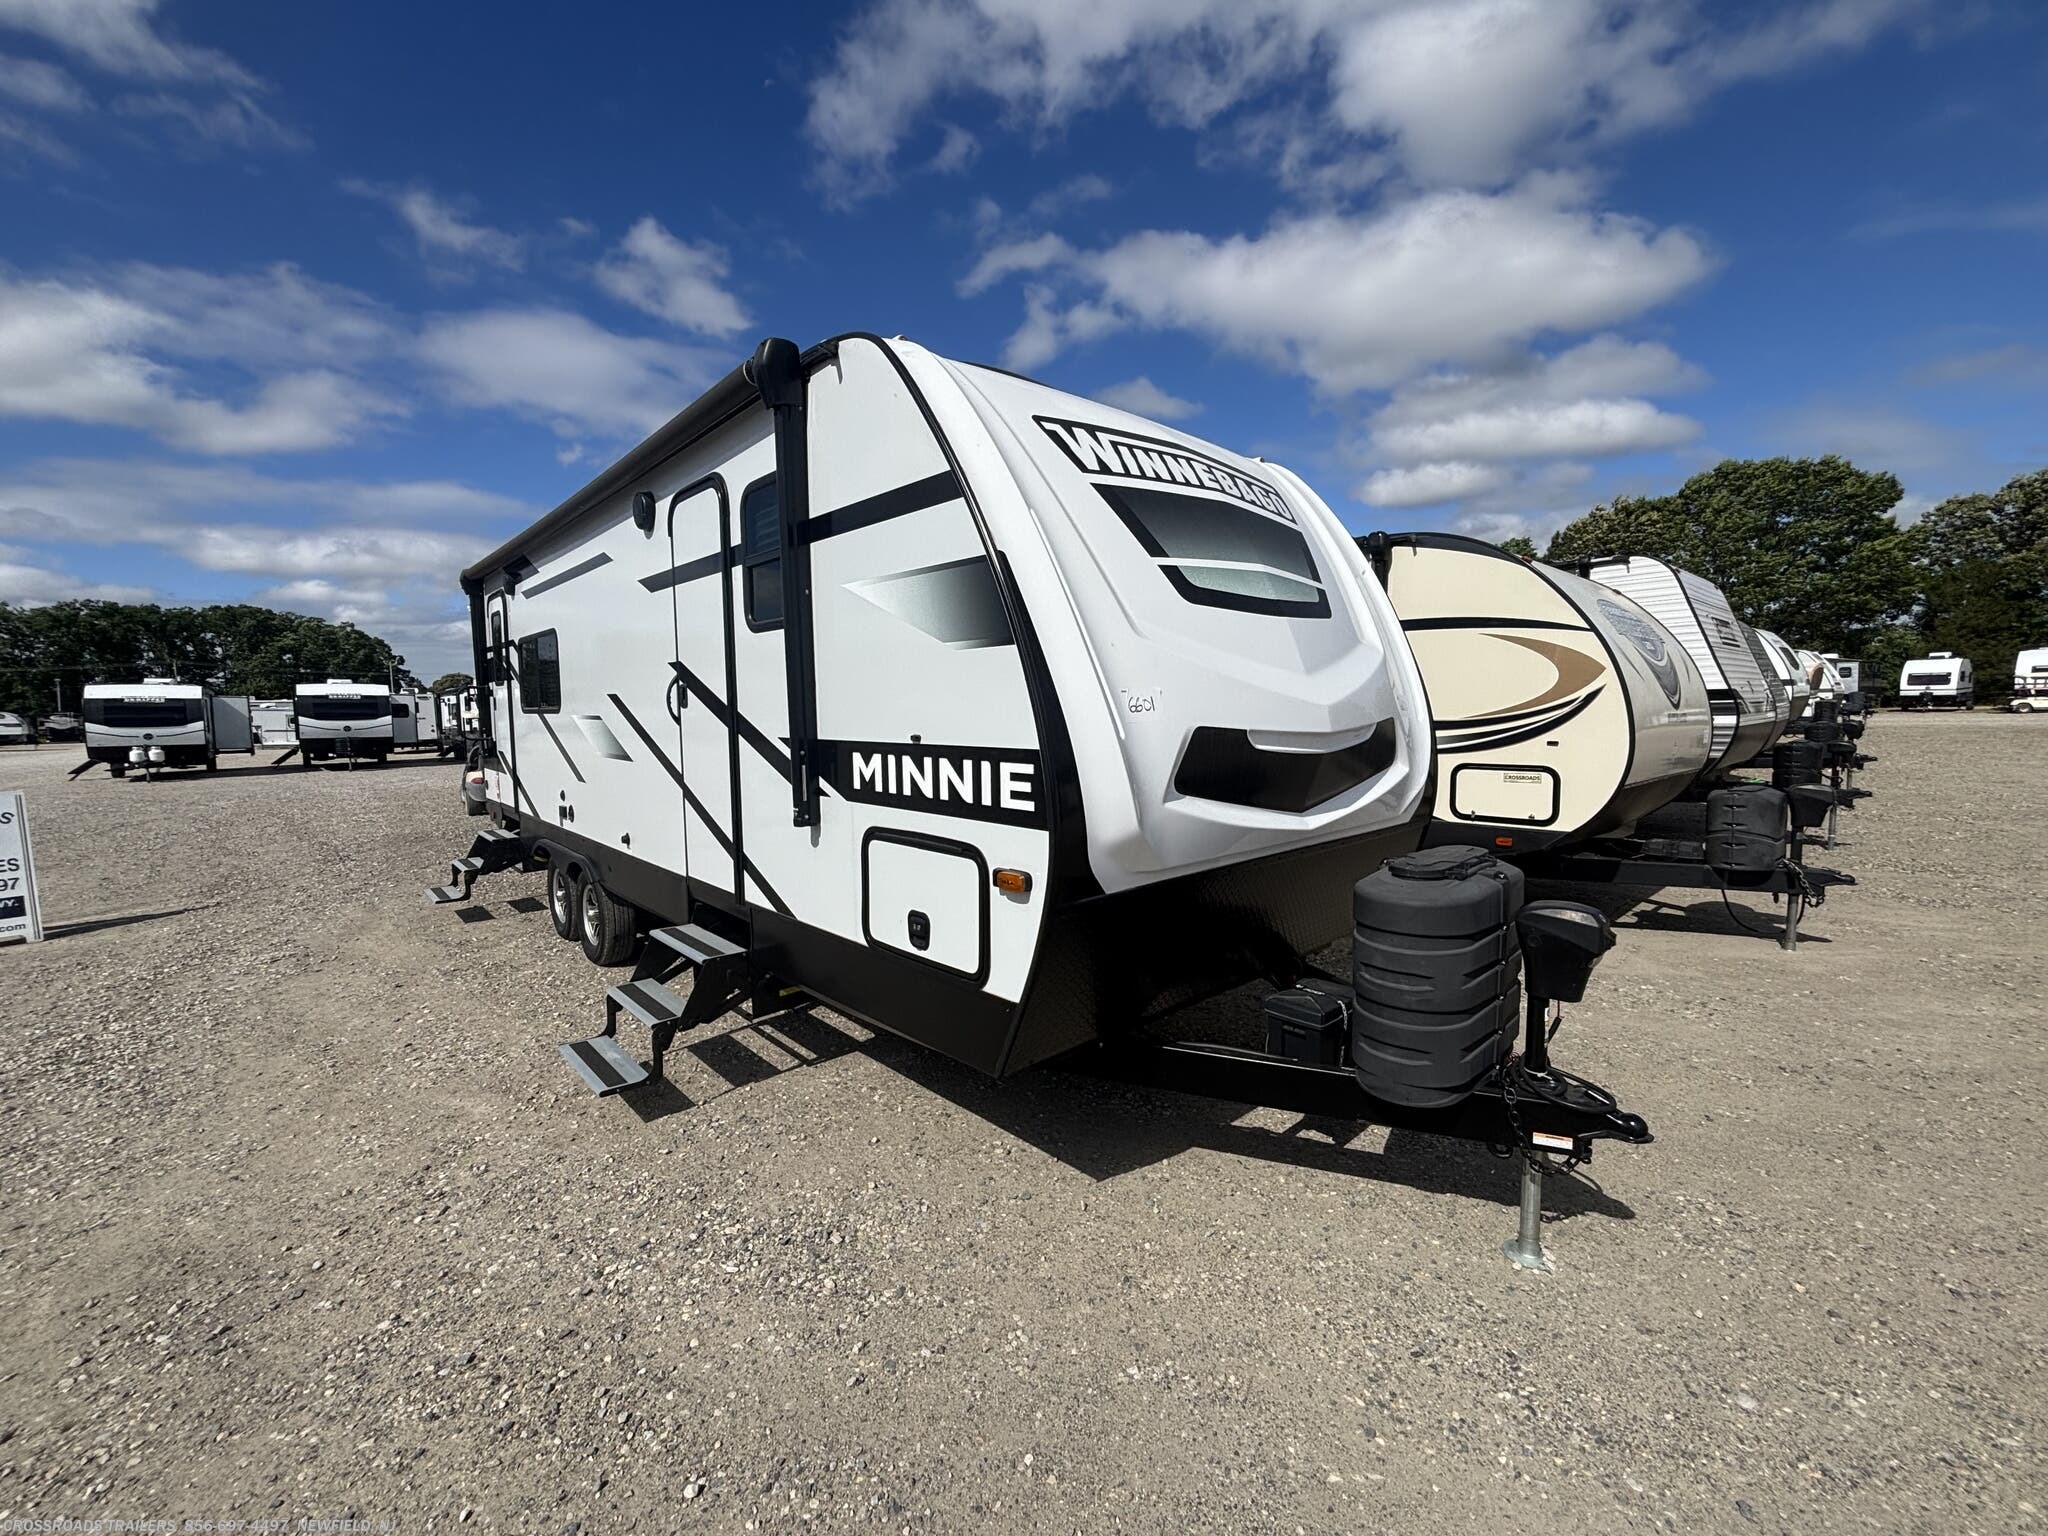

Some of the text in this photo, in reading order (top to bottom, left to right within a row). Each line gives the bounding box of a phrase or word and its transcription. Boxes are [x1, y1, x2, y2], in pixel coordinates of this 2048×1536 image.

[1040, 421, 1294, 520] WINNEBAGO
[1128, 696, 1155, 713] 6601
[852, 751, 1035, 812] MINNIE
